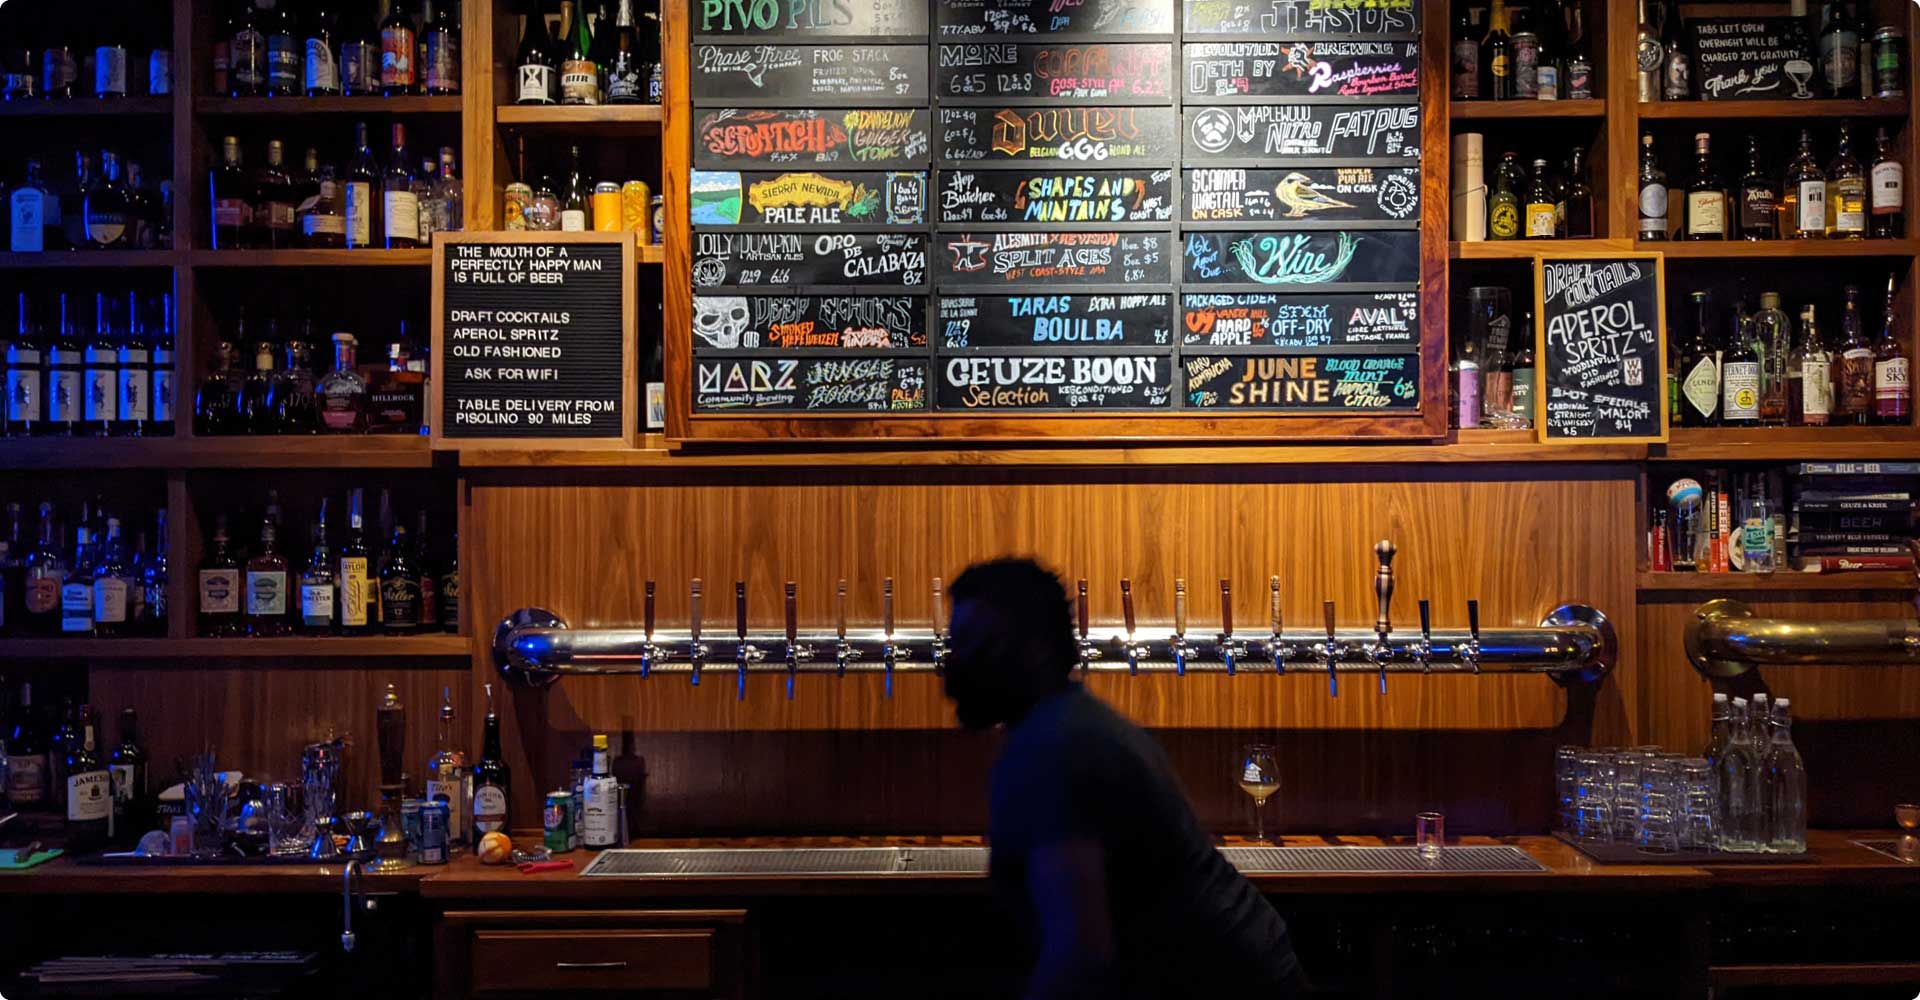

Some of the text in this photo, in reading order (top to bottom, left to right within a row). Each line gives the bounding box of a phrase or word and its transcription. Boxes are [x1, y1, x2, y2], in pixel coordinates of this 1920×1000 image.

[700, 0, 779, 30] PIVO
[785, 0, 854, 29] PILS
[1697, 24, 1764, 34] TABS LEFT OPEN
[1313, 42, 1394, 56] BREWING
[1700, 36, 1778, 49] OVERNIGHT WILL BE
[698, 45, 800, 69] Phase Three
[813, 49, 890, 64] FROG STACK
[940, 44, 1018, 67] MORE
[1701, 50, 1800, 62] CHARGED 20% GRATUITY
[1190, 60, 1244, 93] DETH
[1253, 60, 1276, 78] BY
[1308, 60, 1402, 94] Raspberries
[1704, 64, 1778, 97] Thank you
[702, 118, 827, 158] SCRATCH
[854, 130, 909, 147] GINGER
[1265, 122, 1323, 154] NITRO
[1028, 176, 1136, 198] SHAPES AND
[1192, 169, 1246, 192] SCAMPER
[761, 182, 841, 199] SIERRA NEVADA
[1337, 184, 1378, 194] ON CASK
[941, 186, 996, 209] Butcher
[1192, 190, 1245, 209] WAGTAIL
[765, 207, 841, 224] PALE ALE
[1129, 209, 1152, 220] COAST
[1192, 209, 1208, 220] ON
[1211, 208, 1244, 218] CASK
[696, 233, 802, 260] JOLLY PUMPKIN
[814, 234, 856, 256] ORO
[992, 233, 1049, 252] ALESMITH
[457, 246, 568, 258] THE MOUTH OF A
[746, 252, 804, 260] ARTISAN ALES
[844, 246, 862, 258] DE
[1259, 234, 1333, 276] Wine
[452, 260, 602, 270] PERFECTLY HAPPY MAN
[843, 251, 926, 278] CALABAZA
[994, 247, 1112, 274] SPLIT ACES
[454, 272, 564, 284] IS FULL OF BEER
[902, 270, 922, 286] 8%
[1564, 262, 1642, 308] COCKTAILS
[1008, 296, 1071, 317] TARAS
[1088, 295, 1167, 312] EXTRA HOPPY ALE
[1186, 295, 1234, 308] PACKAGED
[452, 311, 570, 324] DRAFT COCKTAILS
[753, 296, 810, 329] DEEP
[940, 309, 958, 318] DE LA
[1278, 304, 1330, 319] STEM
[1349, 308, 1406, 325] AVAL
[1032, 316, 1124, 342] BOULBA
[1216, 318, 1252, 332] HARD
[1271, 318, 1334, 336] OFF-DRY
[1548, 300, 1645, 346] APEROL
[453, 328, 559, 340] APEROL SPRITZ
[768, 321, 814, 342] SMOKED
[1209, 331, 1252, 345] APPLE
[1640, 330, 1655, 344] $12
[781, 332, 840, 348] HEFEWEIZEN
[453, 346, 561, 358] OLD FASHIONED
[946, 357, 1066, 387] GEUZE
[1070, 356, 1157, 385] BOON
[1242, 357, 1317, 382] JUNE
[1325, 358, 1360, 371] BLOOD
[1562, 354, 1621, 376] WOODINVILLE
[464, 368, 558, 380] ASK FOR WIFI
[1188, 358, 1234, 392] KOMBUCHA
[1885, 373, 1906, 382] SKY
[371, 393, 414, 402] HILLROCK
[697, 393, 796, 406] Community Brewing
[891, 388, 912, 400] PALE
[962, 384, 1050, 408] Selection
[1230, 380, 1330, 404] SHINE
[1552, 387, 1649, 412] SHOT SPECIALS
[458, 399, 614, 412] TABLE DELIVERY FROM
[1344, 394, 1392, 408] CITRUS
[1547, 402, 1589, 411] CARDINAL
[456, 413, 592, 425] PISOLINO 90 MILES
[1547, 418, 1562, 427] RYE
[1554, 410, 1592, 419] STRAIGHT
[1563, 427, 1578, 436] $5
[1614, 419, 1632, 432] $4
[1836, 463, 1880, 474] ATLAS BEER
